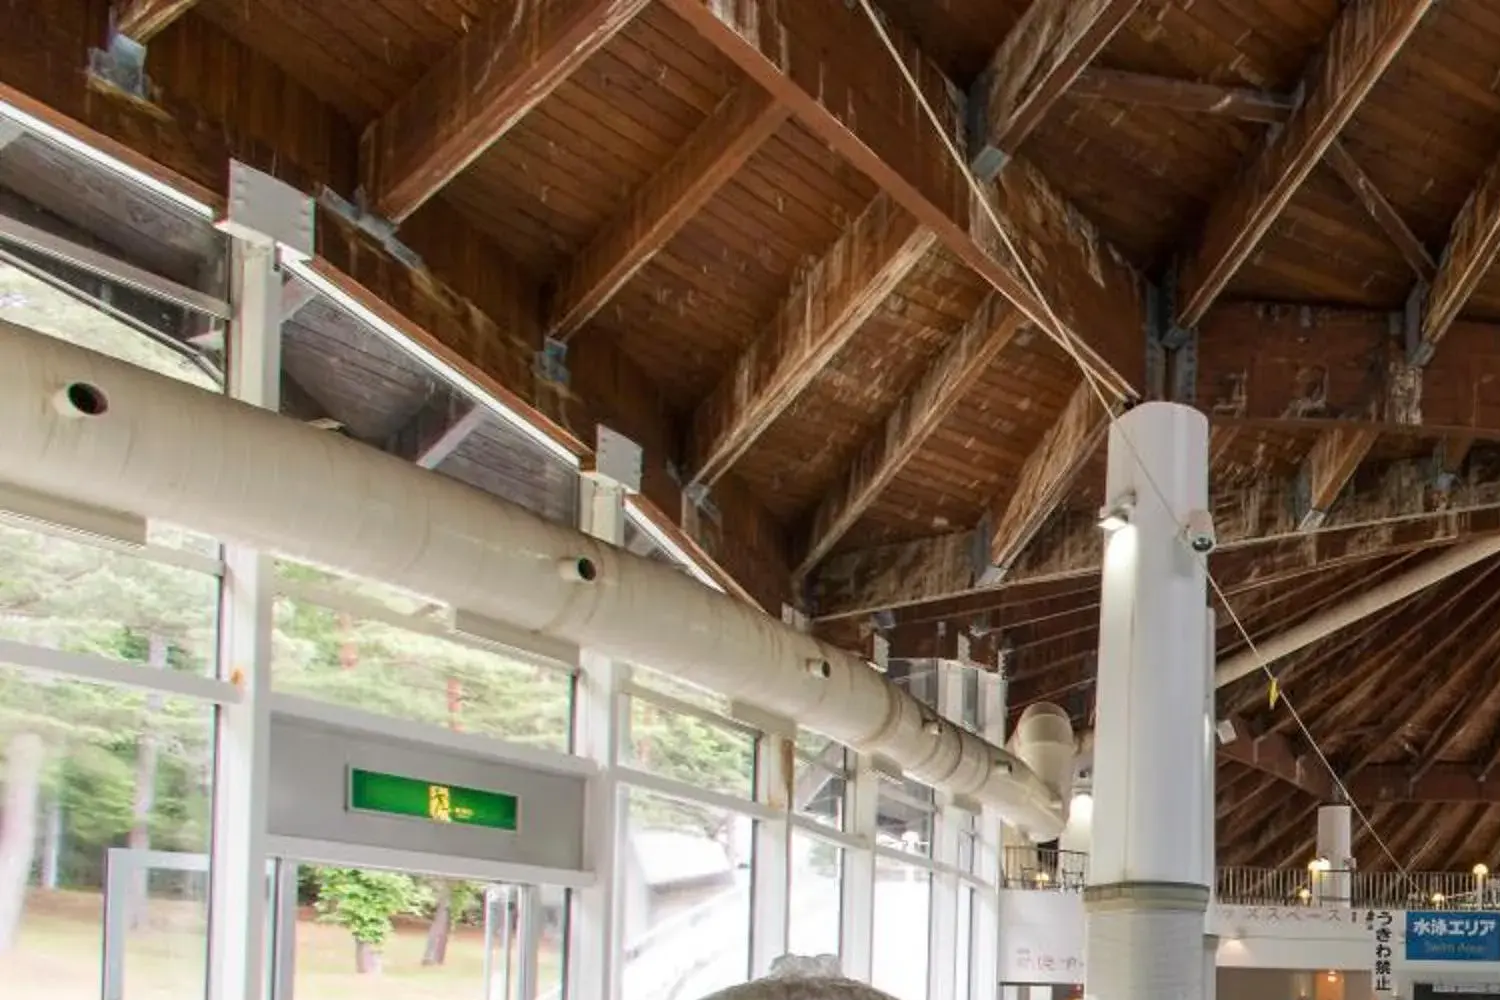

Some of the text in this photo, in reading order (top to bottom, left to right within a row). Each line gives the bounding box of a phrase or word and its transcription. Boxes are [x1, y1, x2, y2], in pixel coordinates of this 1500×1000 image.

[1375, 911, 1393, 991] うきわ禁止
[1413, 919, 1497, 937] 水泳エリア
